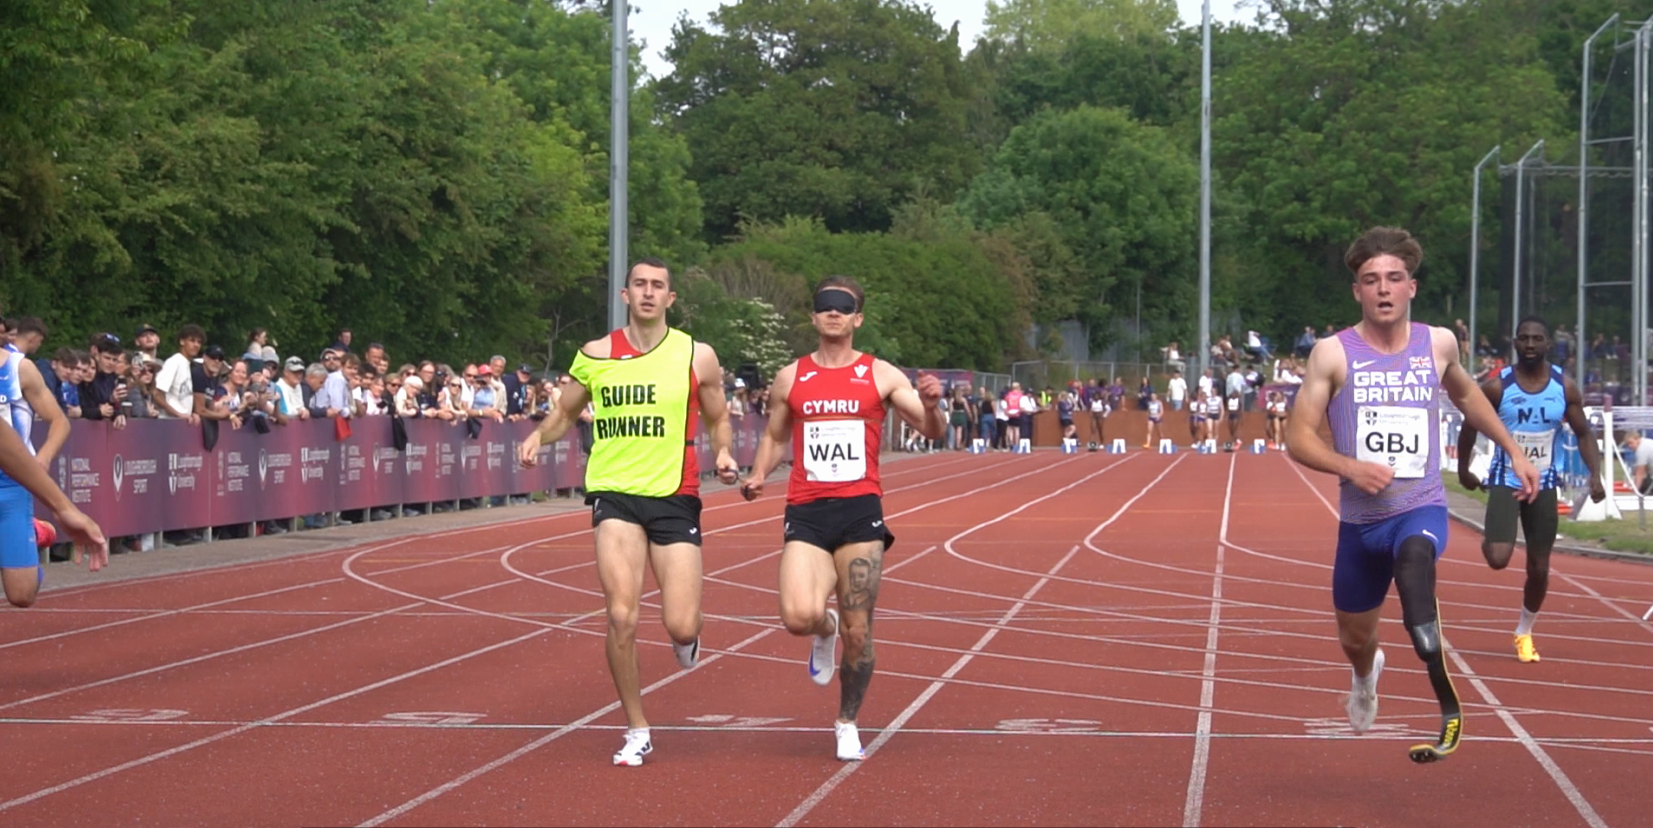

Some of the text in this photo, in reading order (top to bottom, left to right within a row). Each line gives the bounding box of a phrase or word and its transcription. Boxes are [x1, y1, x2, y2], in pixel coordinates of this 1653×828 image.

[1353, 369, 1431, 386] GREAT
[601, 384, 656, 408] GUIDE
[1353, 386, 1433, 403] BRITAIN
[803, 400, 859, 414] CYMRU
[596, 416, 665, 440] RUNNER
[809, 442, 859, 462] WAL
[1365, 431, 1419, 454] GBJ
